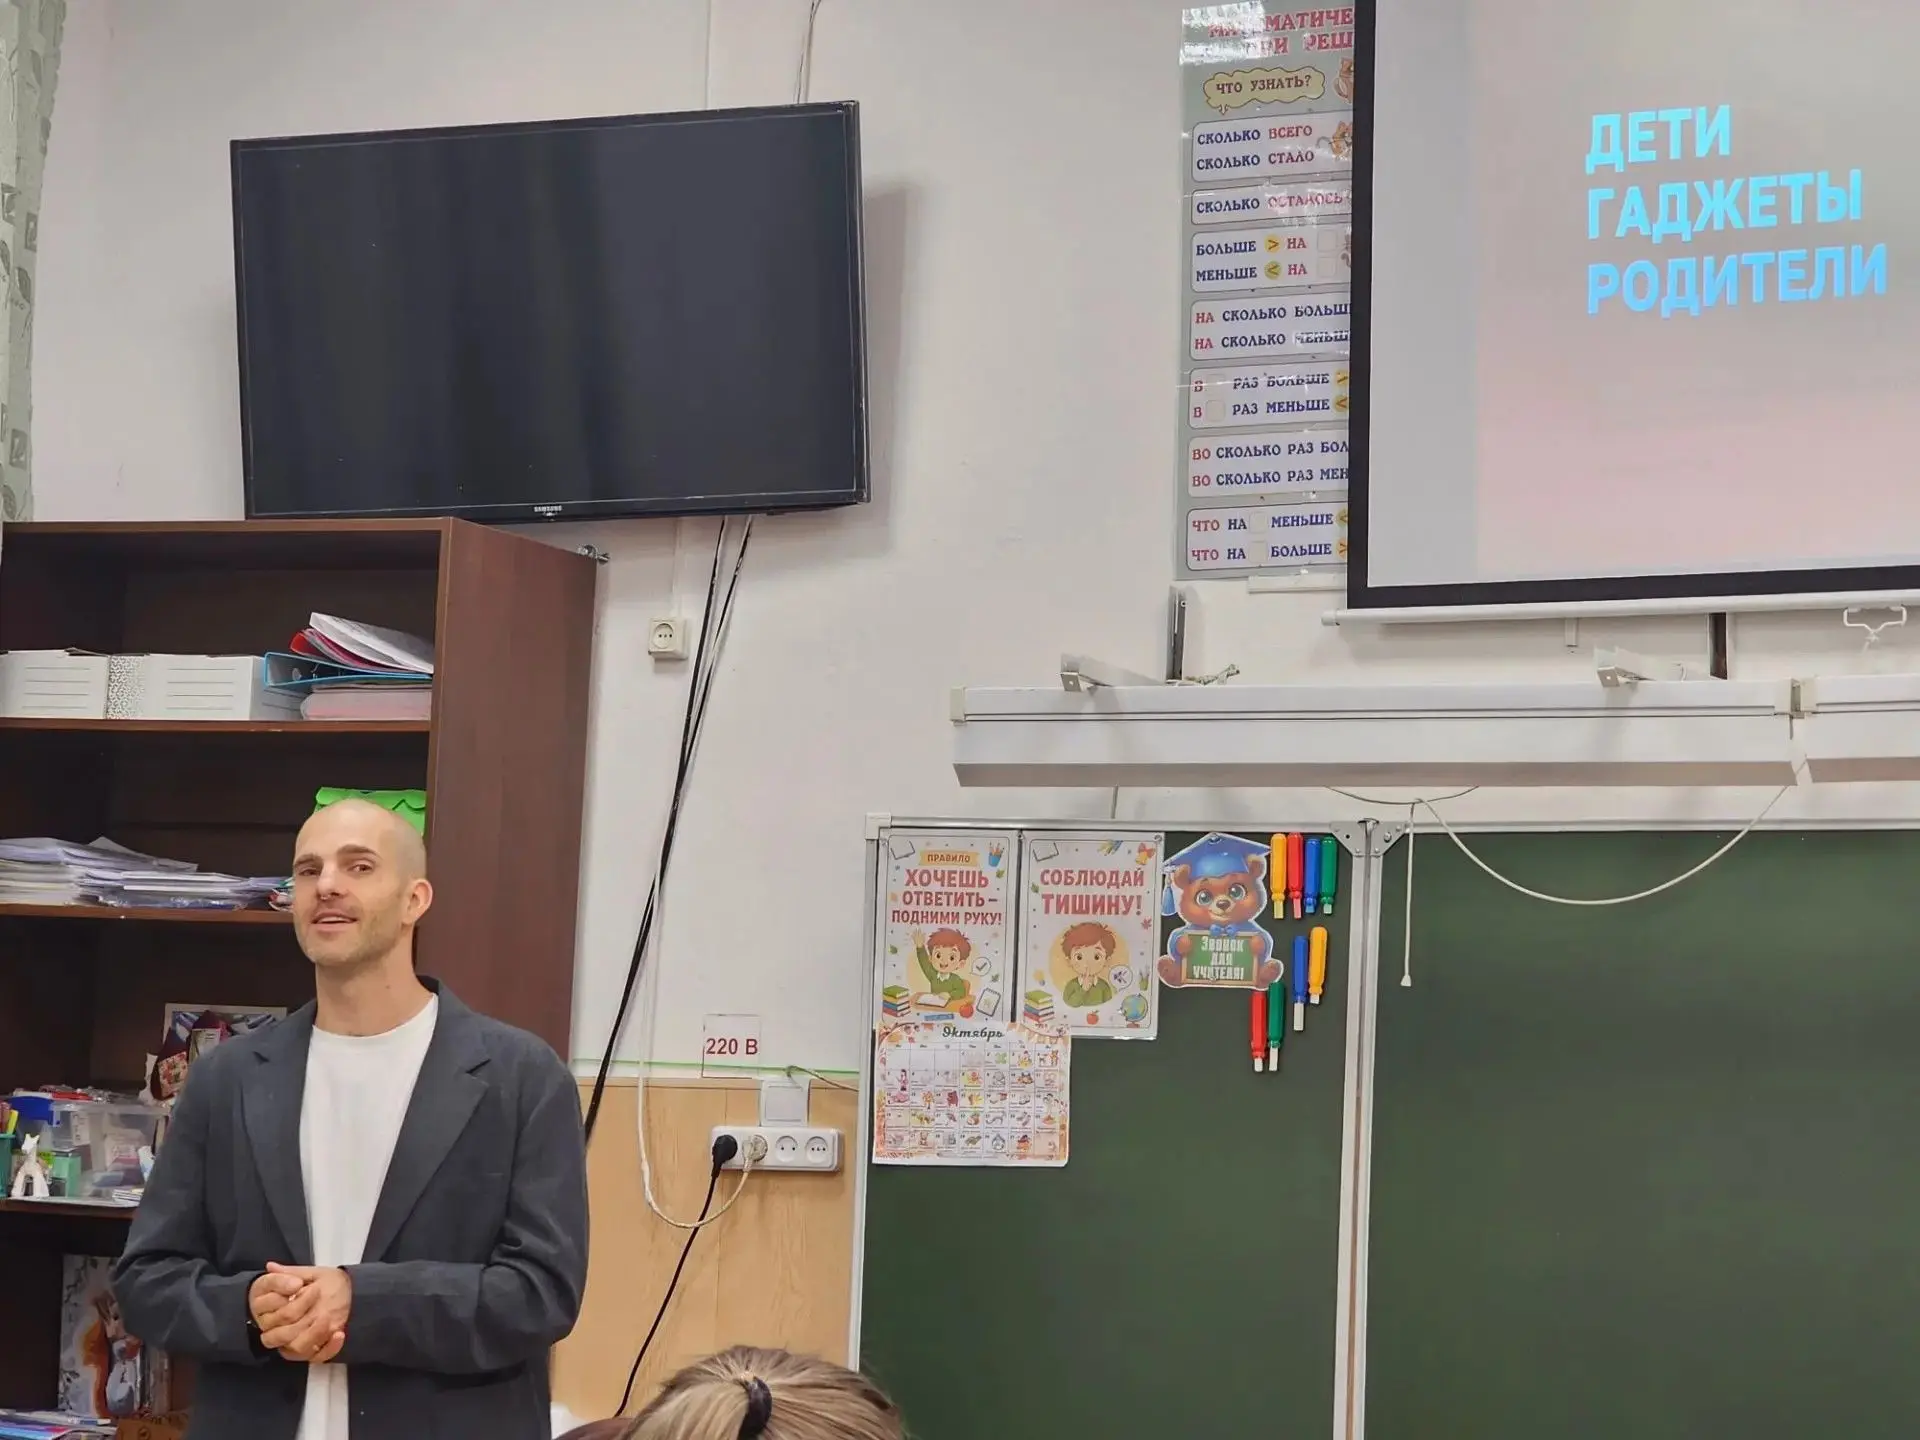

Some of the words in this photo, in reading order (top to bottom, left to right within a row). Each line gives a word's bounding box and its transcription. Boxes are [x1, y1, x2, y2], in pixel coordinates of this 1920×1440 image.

[1216, 82, 1243, 95] ЧТО
[1251, 75, 1312, 92] УЗНАТЬ?
[1197, 129, 1261, 145] СКОЛЬКО
[1269, 125, 1313, 140] ВСЕГО
[1585, 104, 1731, 174] ДЕТИ
[1197, 154, 1261, 170] СКОЛЬКО
[1268, 151, 1314, 164] СТАЛО
[1197, 198, 1260, 213] СКОЛЬКО
[1268, 193, 1343, 208] ОСТАЛОСЬ
[1587, 168, 1862, 244] ГАДЖЕТЫ
[1196, 241, 1257, 256] БОЛЬШЕ
[1287, 238, 1307, 249] НА
[1196, 267, 1258, 281] МЕНЬШЕ
[1288, 264, 1308, 275] НА
[1586, 242, 1887, 319] РОДИТЕЛИ
[1195, 312, 1215, 324] НА
[1222, 307, 1287, 321] СКОЛЬКО
[1295, 303, 1351, 318] БОЛЬШ
[1195, 338, 1214, 349] НА
[1221, 333, 1286, 348] СКОЛЬКО
[1233, 376, 1258, 390] РАЗ
[1266, 373, 1330, 388] БОЛЬШЕ
[1193, 406, 1203, 418] В
[1232, 402, 1258, 416] РАЗ
[1266, 399, 1330, 413] МЕНЬШЕ
[1192, 448, 1211, 460] ВО
[1216, 444, 1281, 459] СКОЛЬКО
[1287, 442, 1314, 455] РАЗ
[1192, 475, 1211, 487] ВО
[1216, 471, 1281, 486] СКОЛЬКО
[1287, 469, 1313, 482] РАЗ
[1320, 468, 1349, 480] МЕН
[1192, 519, 1220, 532] ЧТО
[1228, 518, 1247, 530] НА
[1271, 513, 1334, 528] МЕНЬШЕ
[1191, 549, 1219, 562] ЧТО
[1227, 548, 1246, 560] НА
[1271, 543, 1332, 558] БОЛЬШЕ
[927, 853, 971, 863] ПРАВИЛО
[905, 868, 989, 888] ХОЧЕШЬ
[1040, 867, 1144, 888] СОБЛЮДАЙ
[902, 891, 985, 907] ОТВЕТИТЬ
[1042, 894, 1142, 916] ТИШИНУ!
[892, 910, 960, 925] ПОДНИМИ
[964, 912, 1002, 926] РУКУ!
[706, 1038, 738, 1055] 220
[745, 1038, 758, 1055] В
